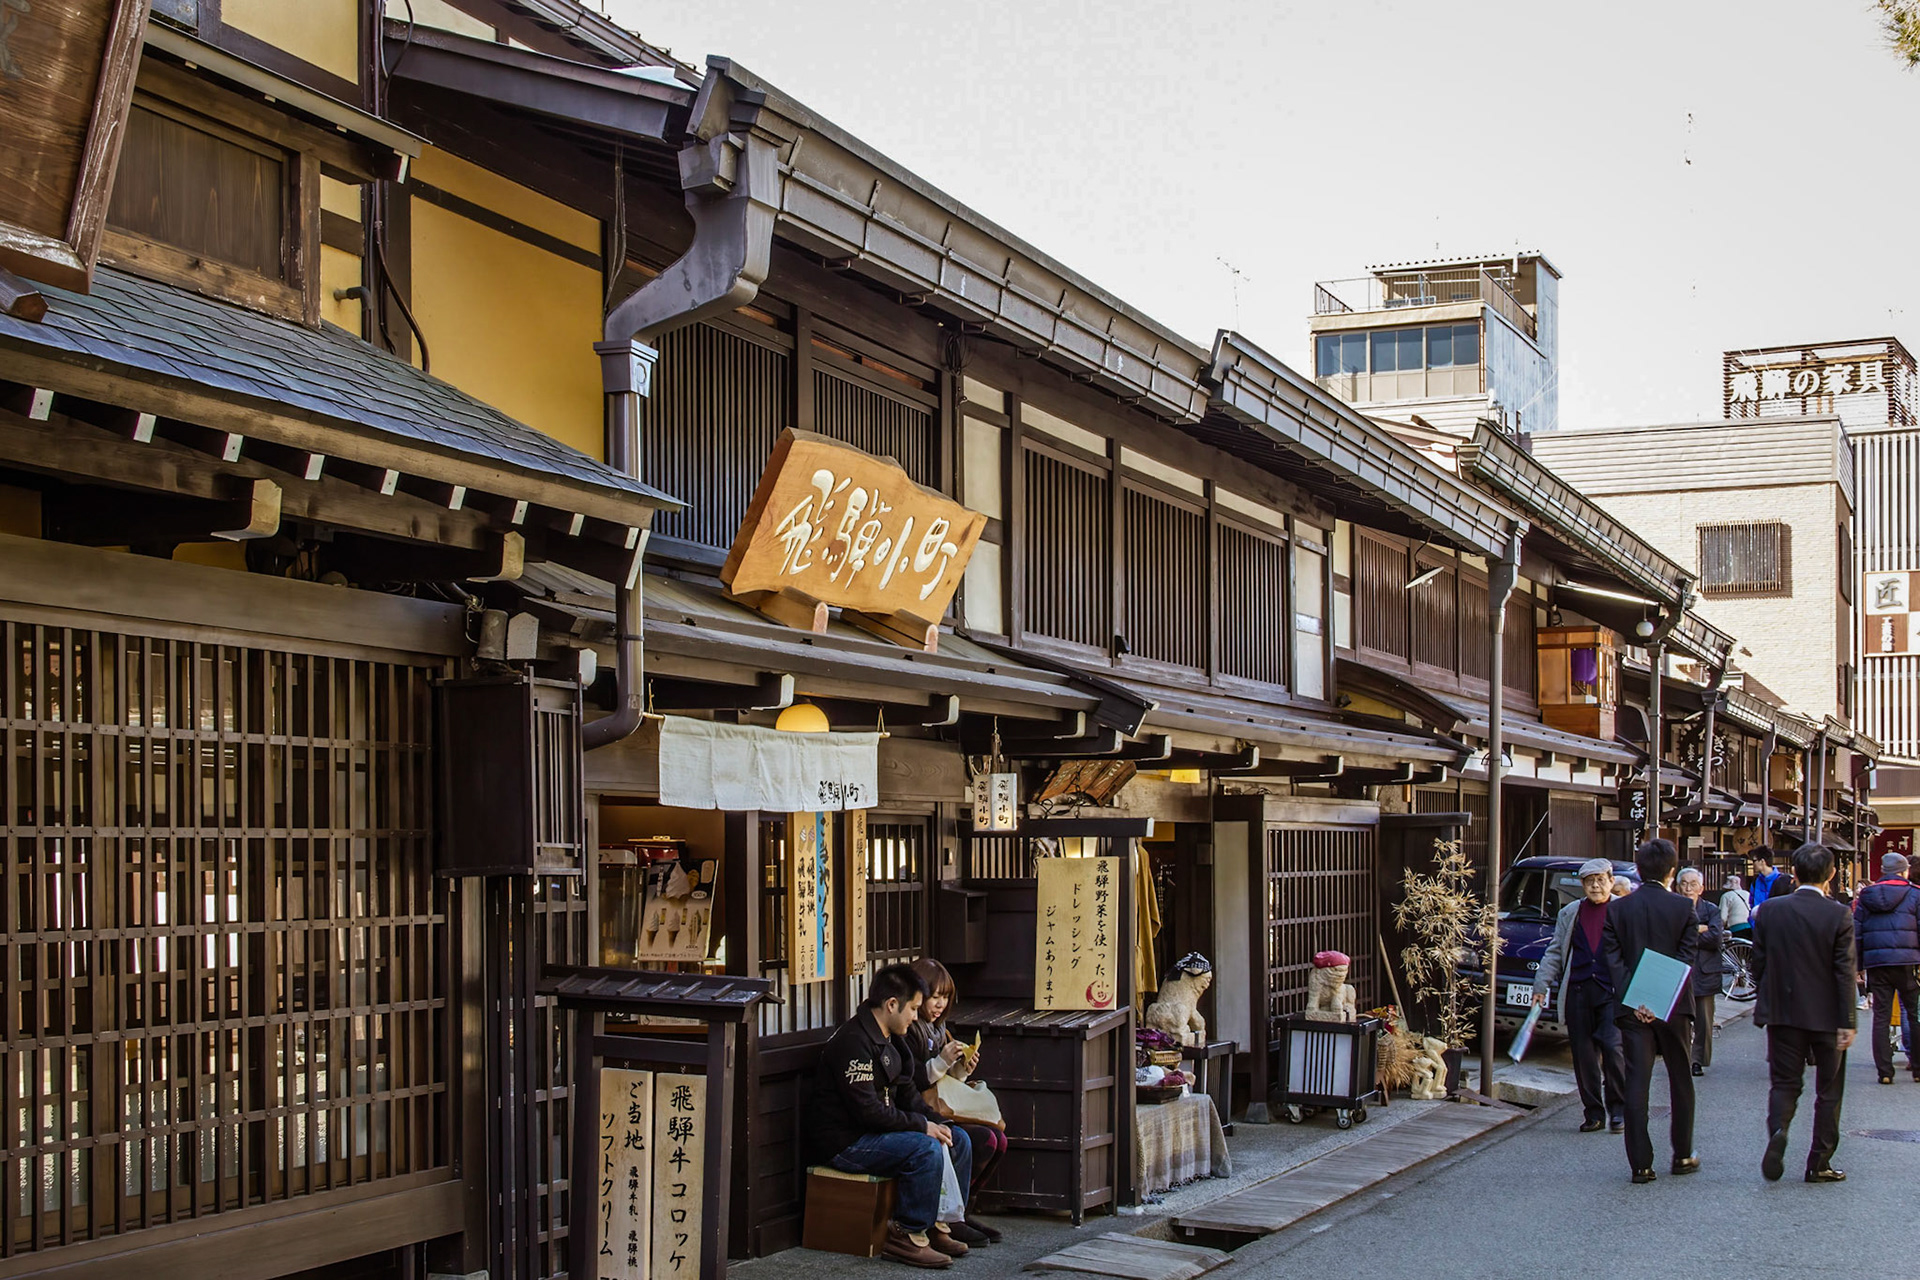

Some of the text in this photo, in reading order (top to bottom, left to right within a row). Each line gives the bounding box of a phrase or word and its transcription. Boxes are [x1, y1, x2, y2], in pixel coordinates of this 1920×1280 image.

[1729, 361, 1889, 403] 飛騨の家具
[773, 468, 958, 601] 飛騨小町
[1875, 577, 1903, 610] 匠
[977, 780, 989, 825] 飛騨小町
[997, 779, 1009, 825] 飛騨小町
[1630, 791, 1647, 819] そば
[1070, 883, 1082, 970] ドレッシング
[1094, 859, 1110, 977] 飛騨野菜を使った
[1043, 905, 1057, 1006] ジャムあります
[845, 1072, 875, 1085] Time
[624, 1081, 645, 1150] ご当地
[600, 1112, 615, 1256] ソフトクリーム
[667, 1085, 695, 1272] 飛騨牛コロッケ
